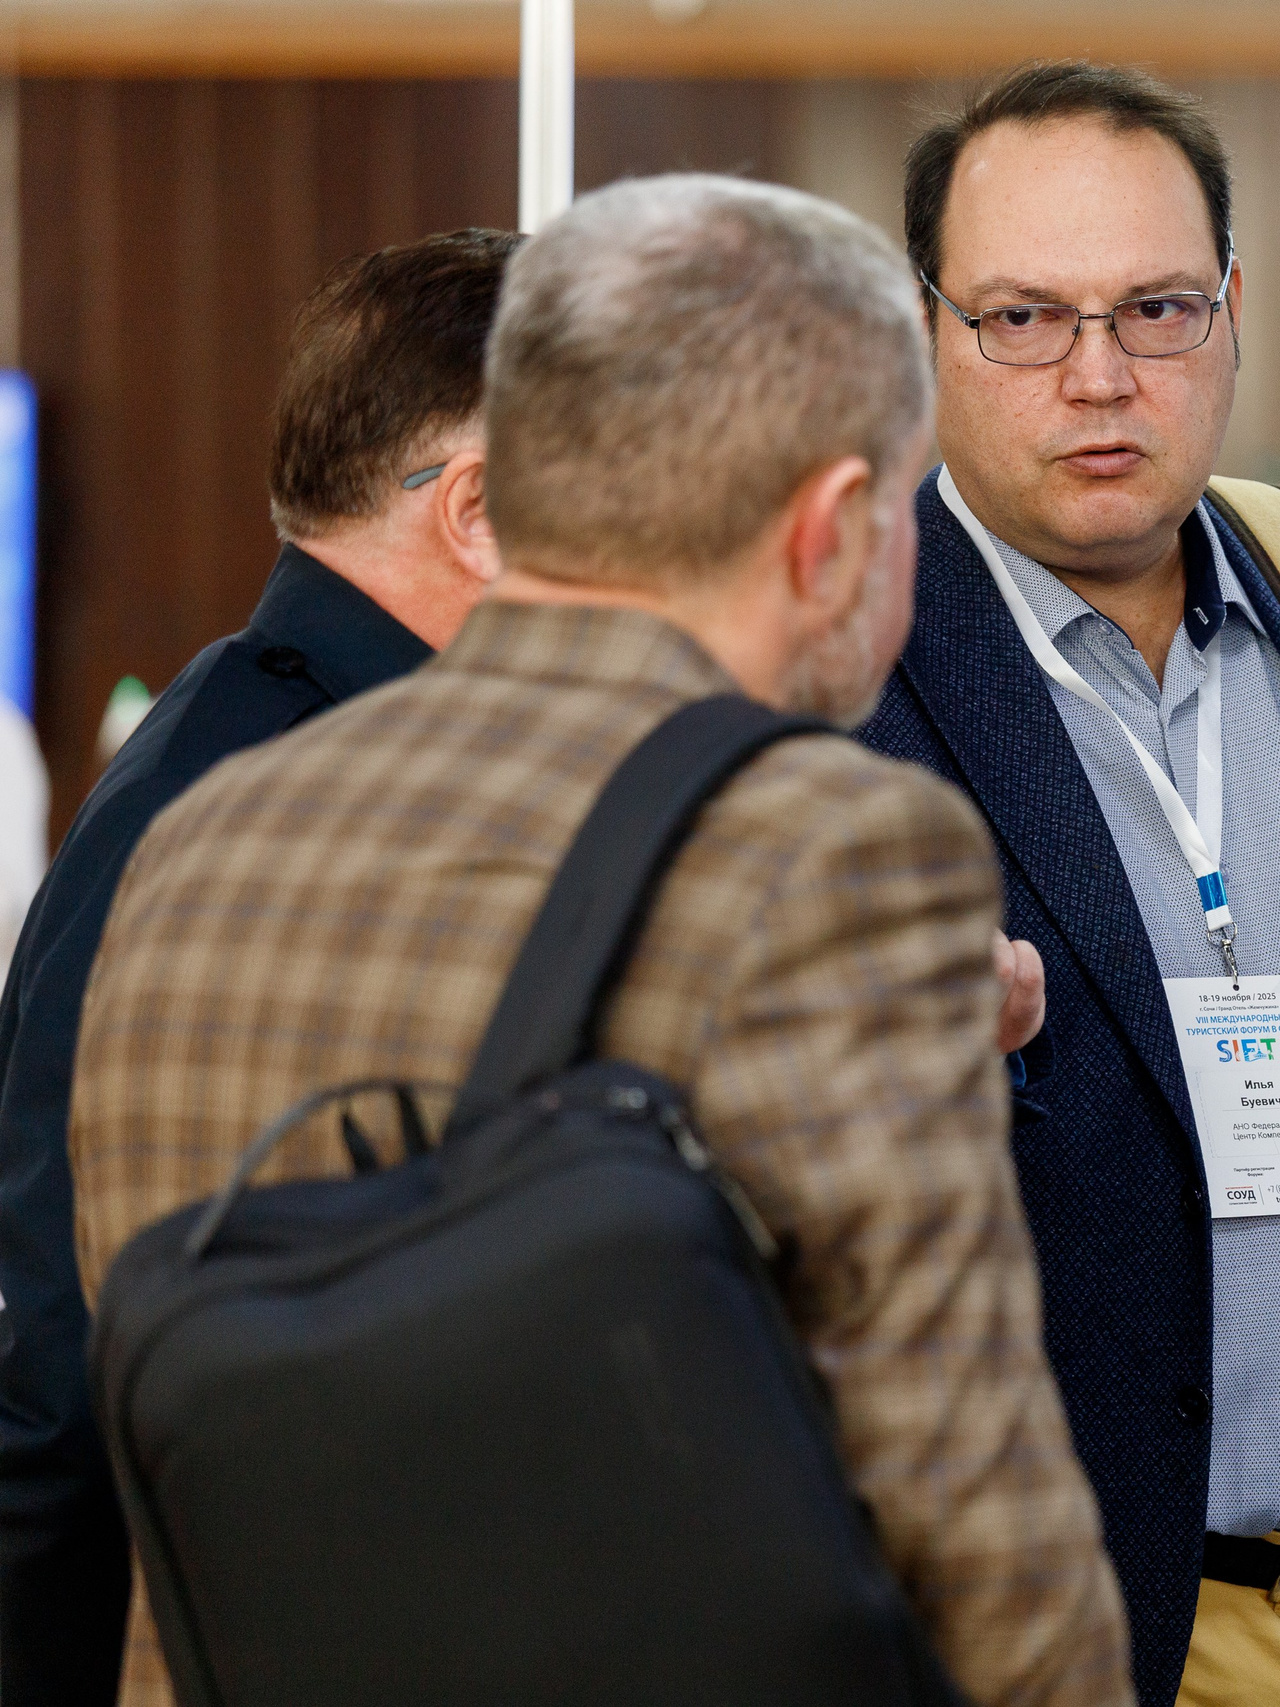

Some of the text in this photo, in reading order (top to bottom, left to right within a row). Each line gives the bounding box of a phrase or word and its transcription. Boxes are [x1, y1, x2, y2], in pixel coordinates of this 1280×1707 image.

[1199, 994, 1220, 1003] 18-19
[1221, 993, 1251, 1002] ноября
[1257, 992, 1277, 1001] 2025
[1195, 1016, 1209, 1024] VIII
[1185, 1025, 1239, 1036] ТУРИСТСКИЙ
[1240, 1025, 1271, 1034] ФОРУМ
[1271, 1025, 1277, 1033] В
[1216, 1038, 1277, 1063] SIFT
[1244, 1079, 1274, 1090] Илья
[1232, 1123, 1250, 1131] АНО
[1232, 1132, 1257, 1141] Центр
[1226, 1190, 1257, 1201] СОУД
